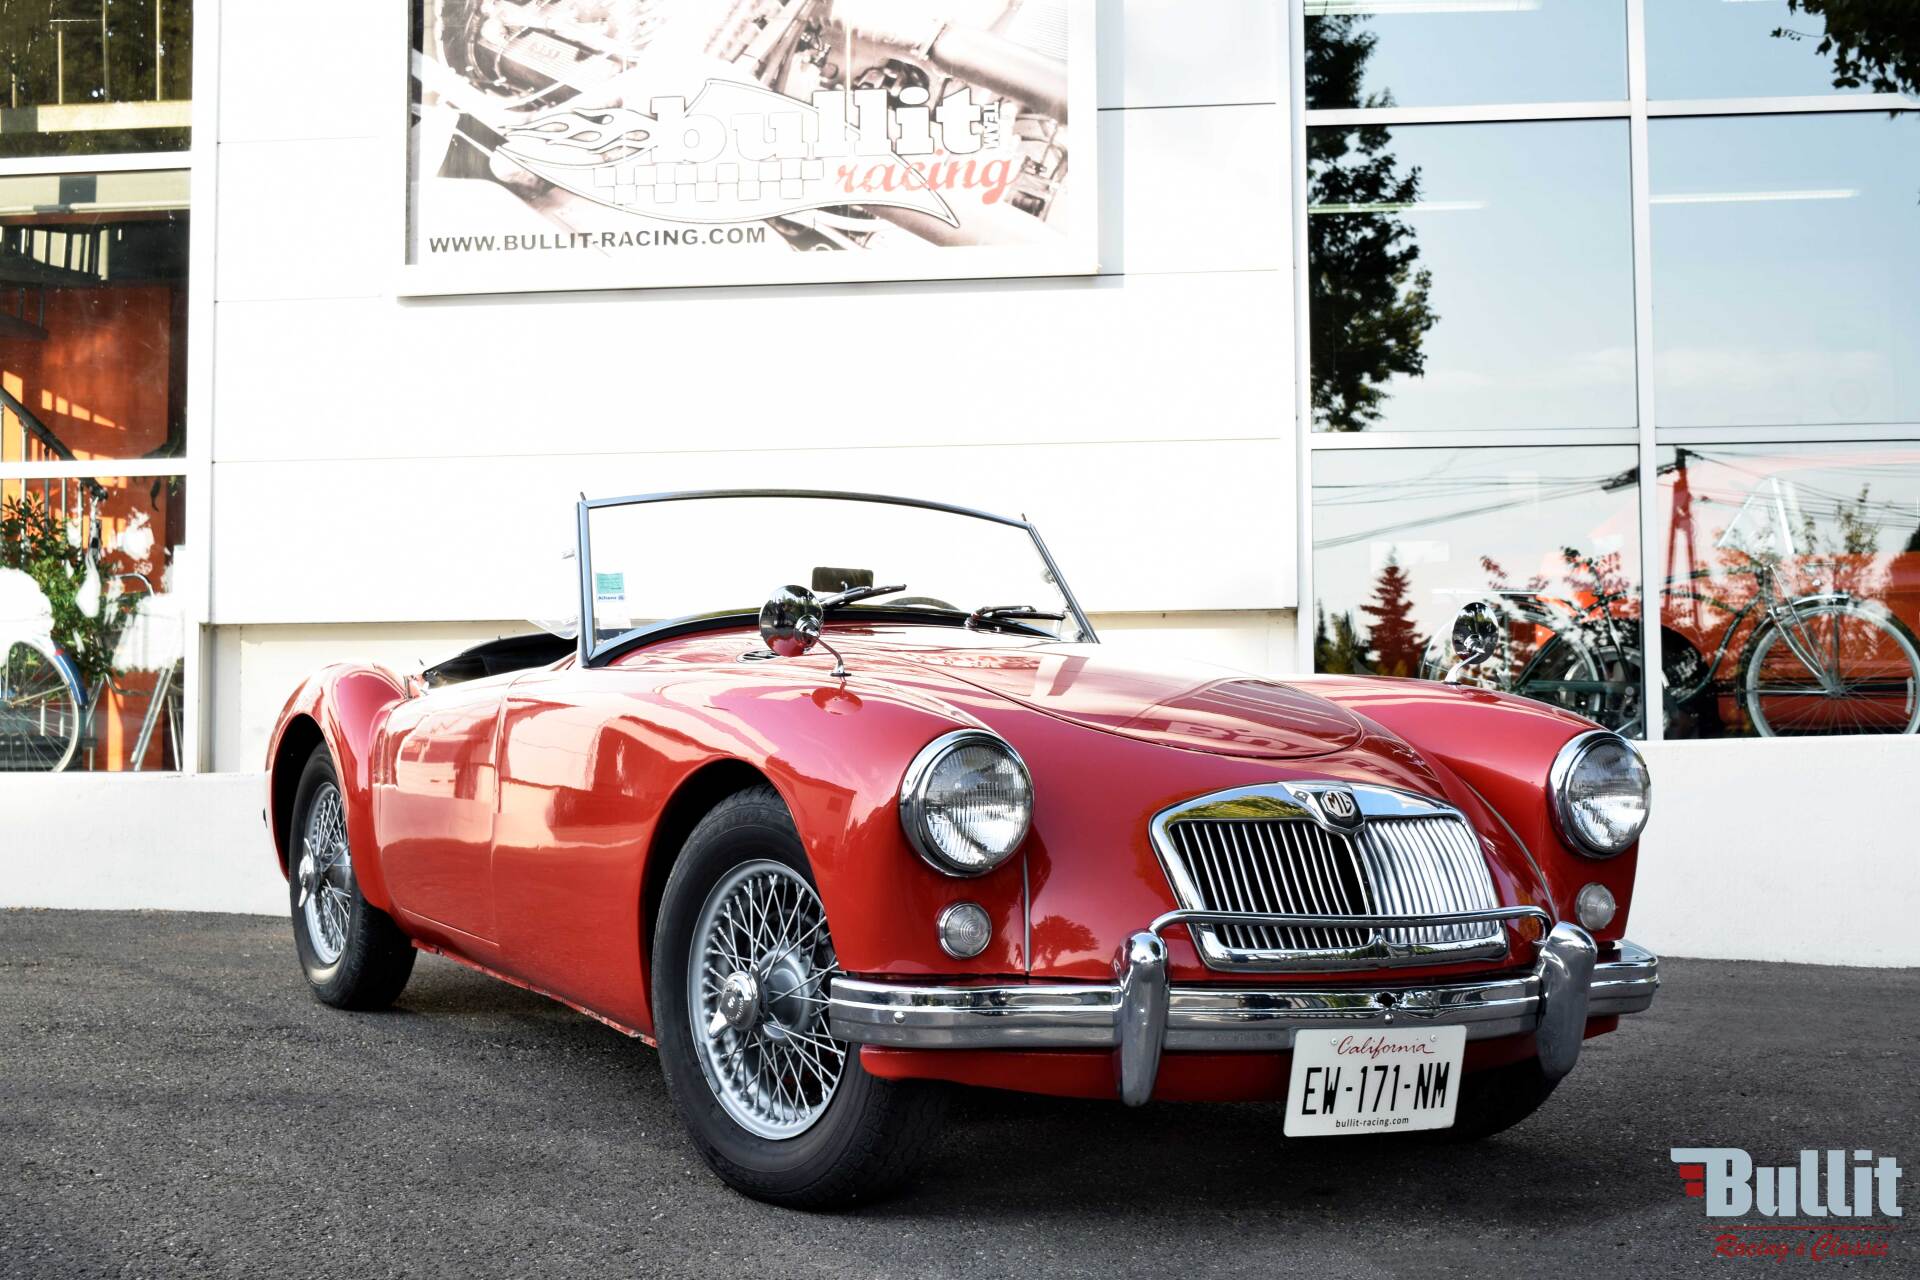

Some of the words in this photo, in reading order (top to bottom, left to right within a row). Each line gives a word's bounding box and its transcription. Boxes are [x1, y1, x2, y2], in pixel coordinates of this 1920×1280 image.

[650, 86, 982, 162] bullit
[835, 148, 1018, 204] racing
[429, 227, 766, 253] WWW.BULLIT-RACING.COM
[1326, 791, 1353, 814] MG
[1337, 1035, 1436, 1060] California
[1301, 1061, 1450, 1115] EW-171-NM
[1335, 1117, 1409, 1128] bullit-racing.com
